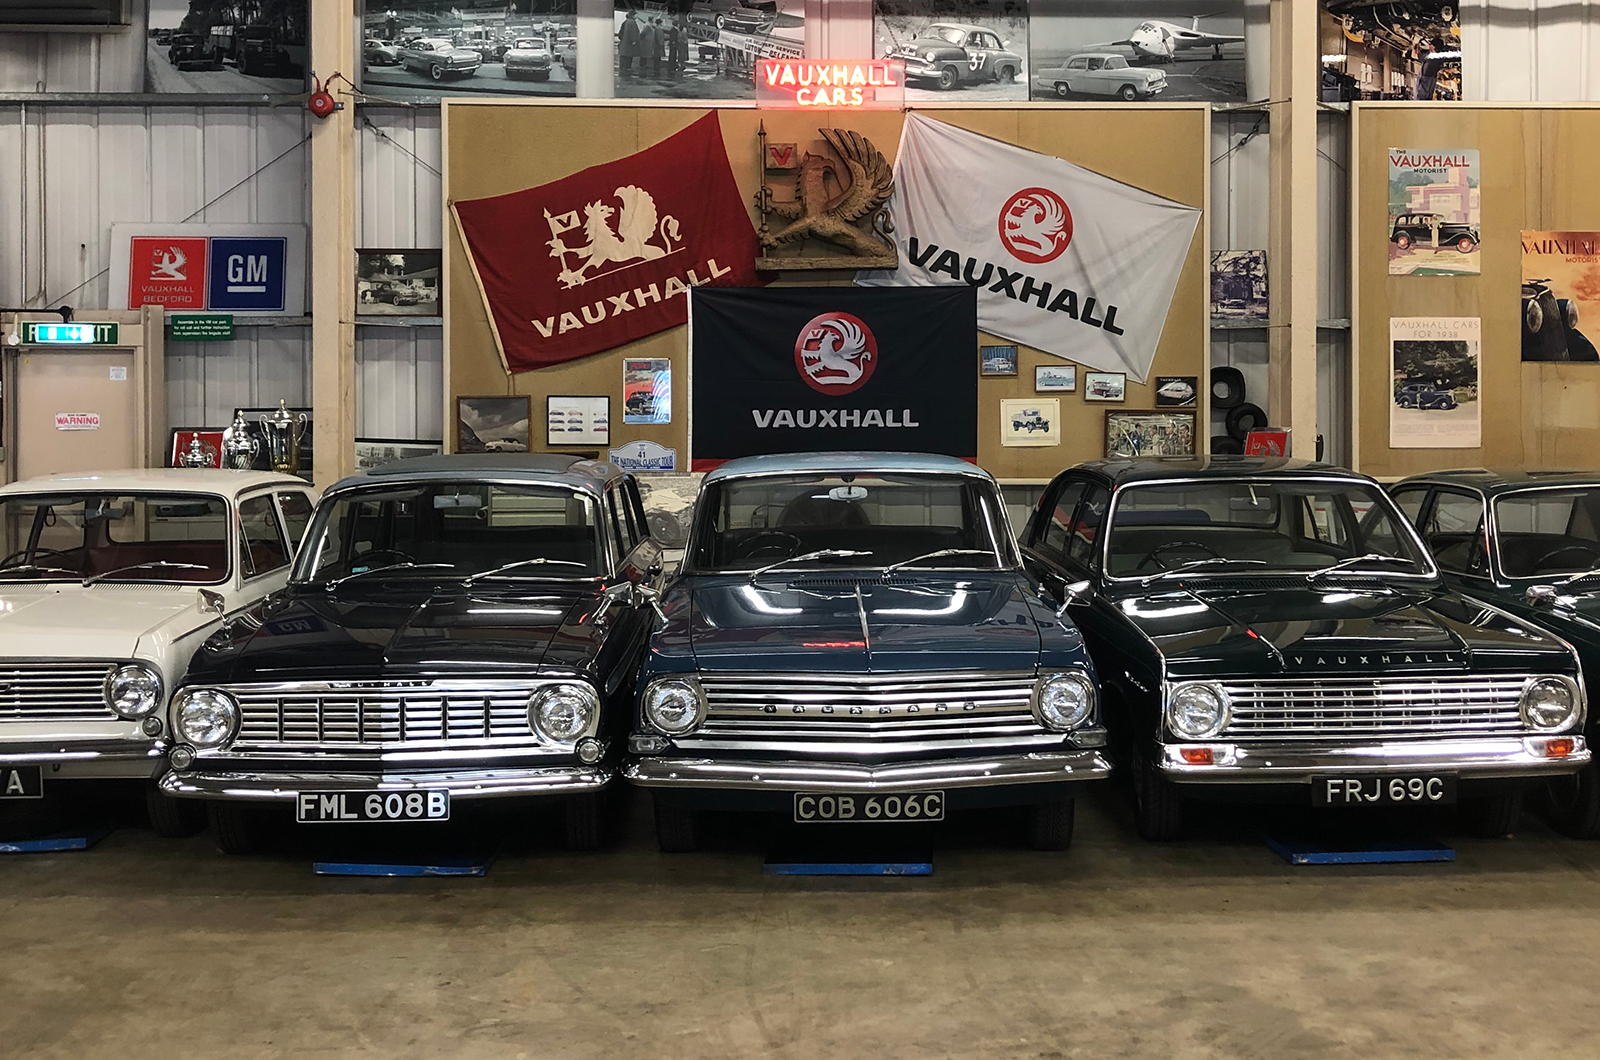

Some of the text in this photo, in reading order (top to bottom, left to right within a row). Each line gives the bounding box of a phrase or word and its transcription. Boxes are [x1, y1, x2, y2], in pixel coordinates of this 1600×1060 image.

[769, 49, 800, 59] BELFA
[775, 46, 801, 56] SERVICE
[969, 52, 986, 71] 37
[765, 64, 897, 86] VAUXHALL
[796, 87, 864, 106] CARS
[1389, 155, 1470, 168] VAUXHALL
[227, 254, 268, 283] GM
[141, 285, 195, 293] VAUXHALL
[908, 236, 1125, 337] VAUXHALL
[143, 295, 193, 303] BEDFORD
[530, 258, 732, 339] VAUXHALL
[1393, 321, 1479, 329] VAUXHALL CARS
[56, 417, 99, 425] WARNING
[751, 408, 920, 428] VAUXHALL
[620, 457, 642, 467] NATIONAL
[643, 457, 661, 467] CLASSIC
[662, 455, 673, 467] TOUR
[1294, 653, 1454, 665] VAUXHALL
[1327, 777, 1443, 803] FRJ 69C
[300, 792, 446, 819] FML 608B
[798, 794, 941, 819] COB 606C
